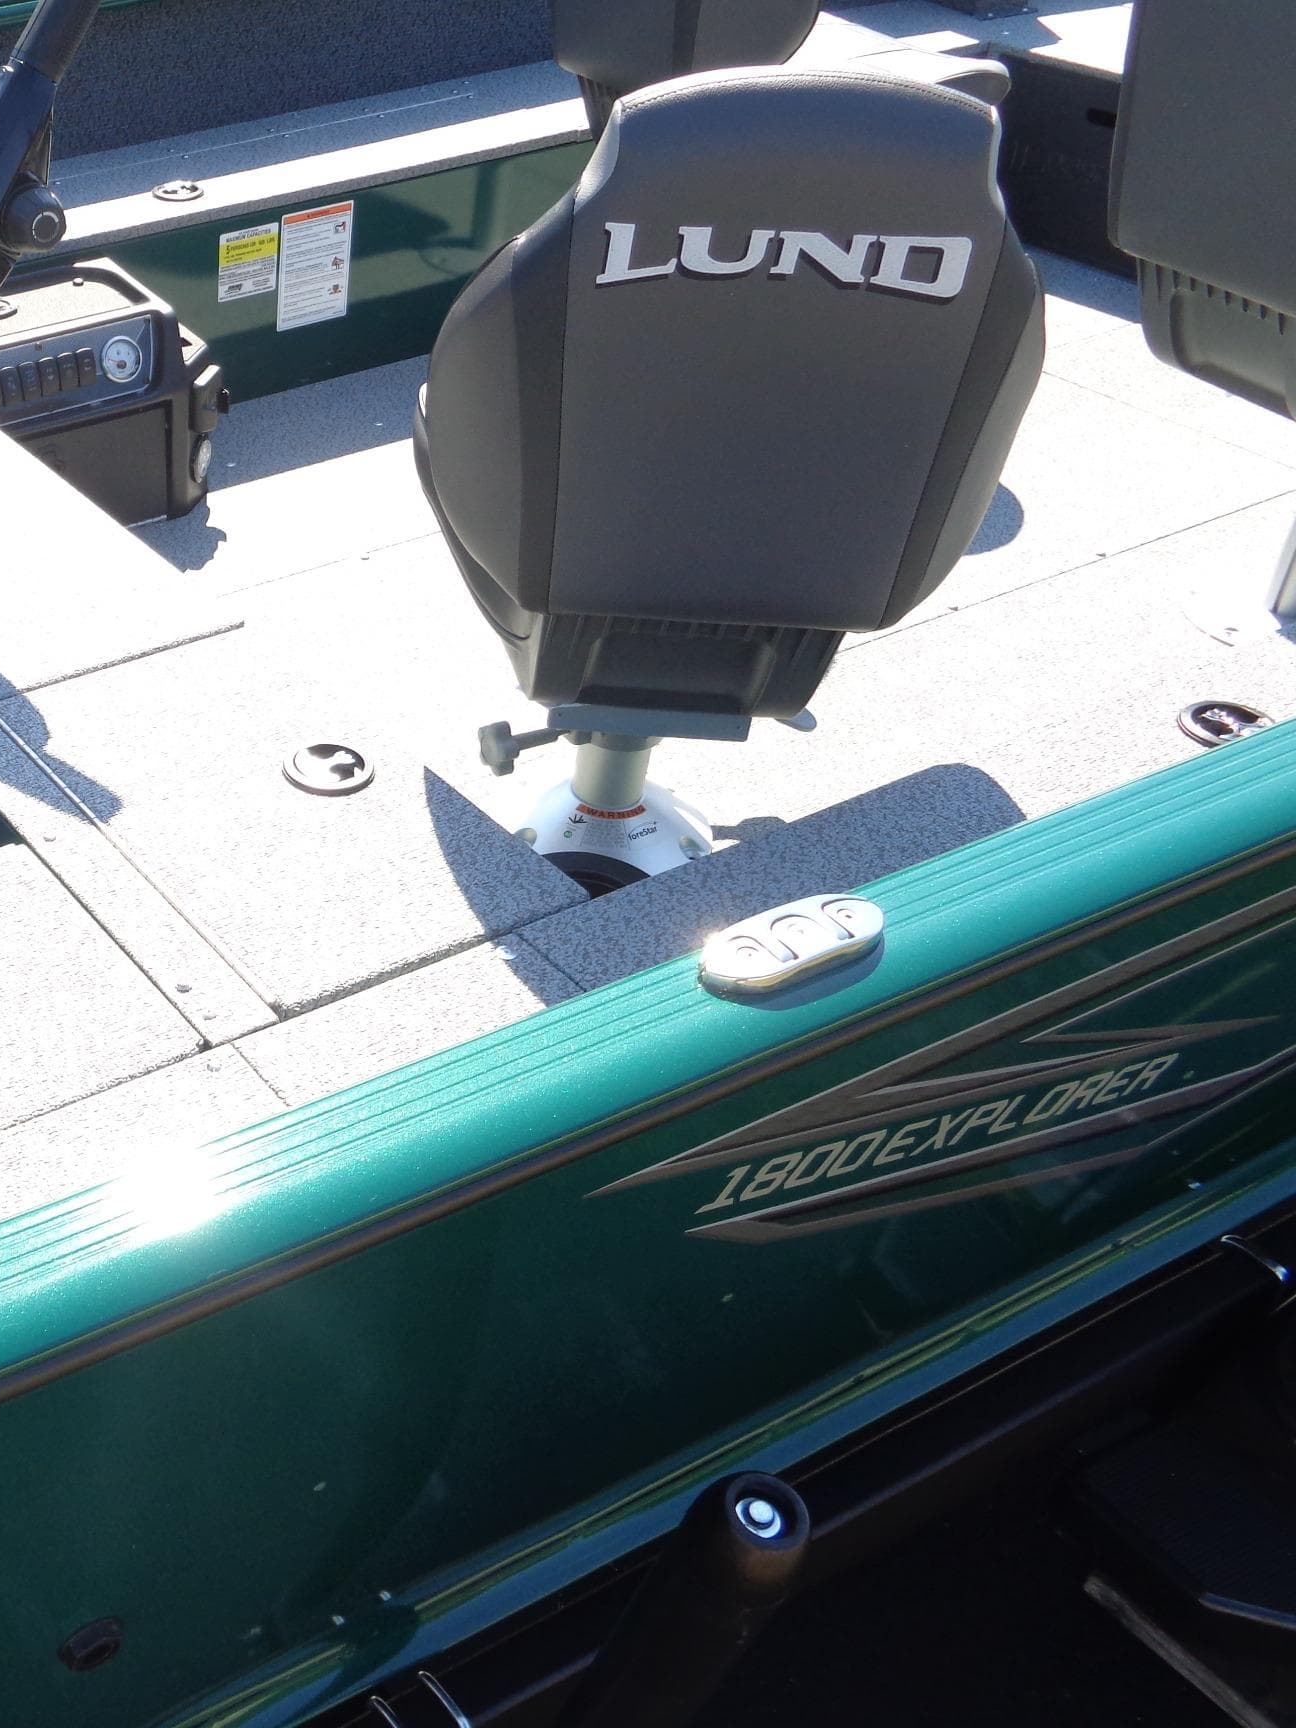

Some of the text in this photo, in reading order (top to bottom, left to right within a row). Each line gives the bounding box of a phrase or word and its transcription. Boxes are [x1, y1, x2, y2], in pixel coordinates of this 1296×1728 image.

[595, 221, 973, 299] LUND
[586, 804, 646, 819] WARNING
[628, 826, 657, 841] foreStar
